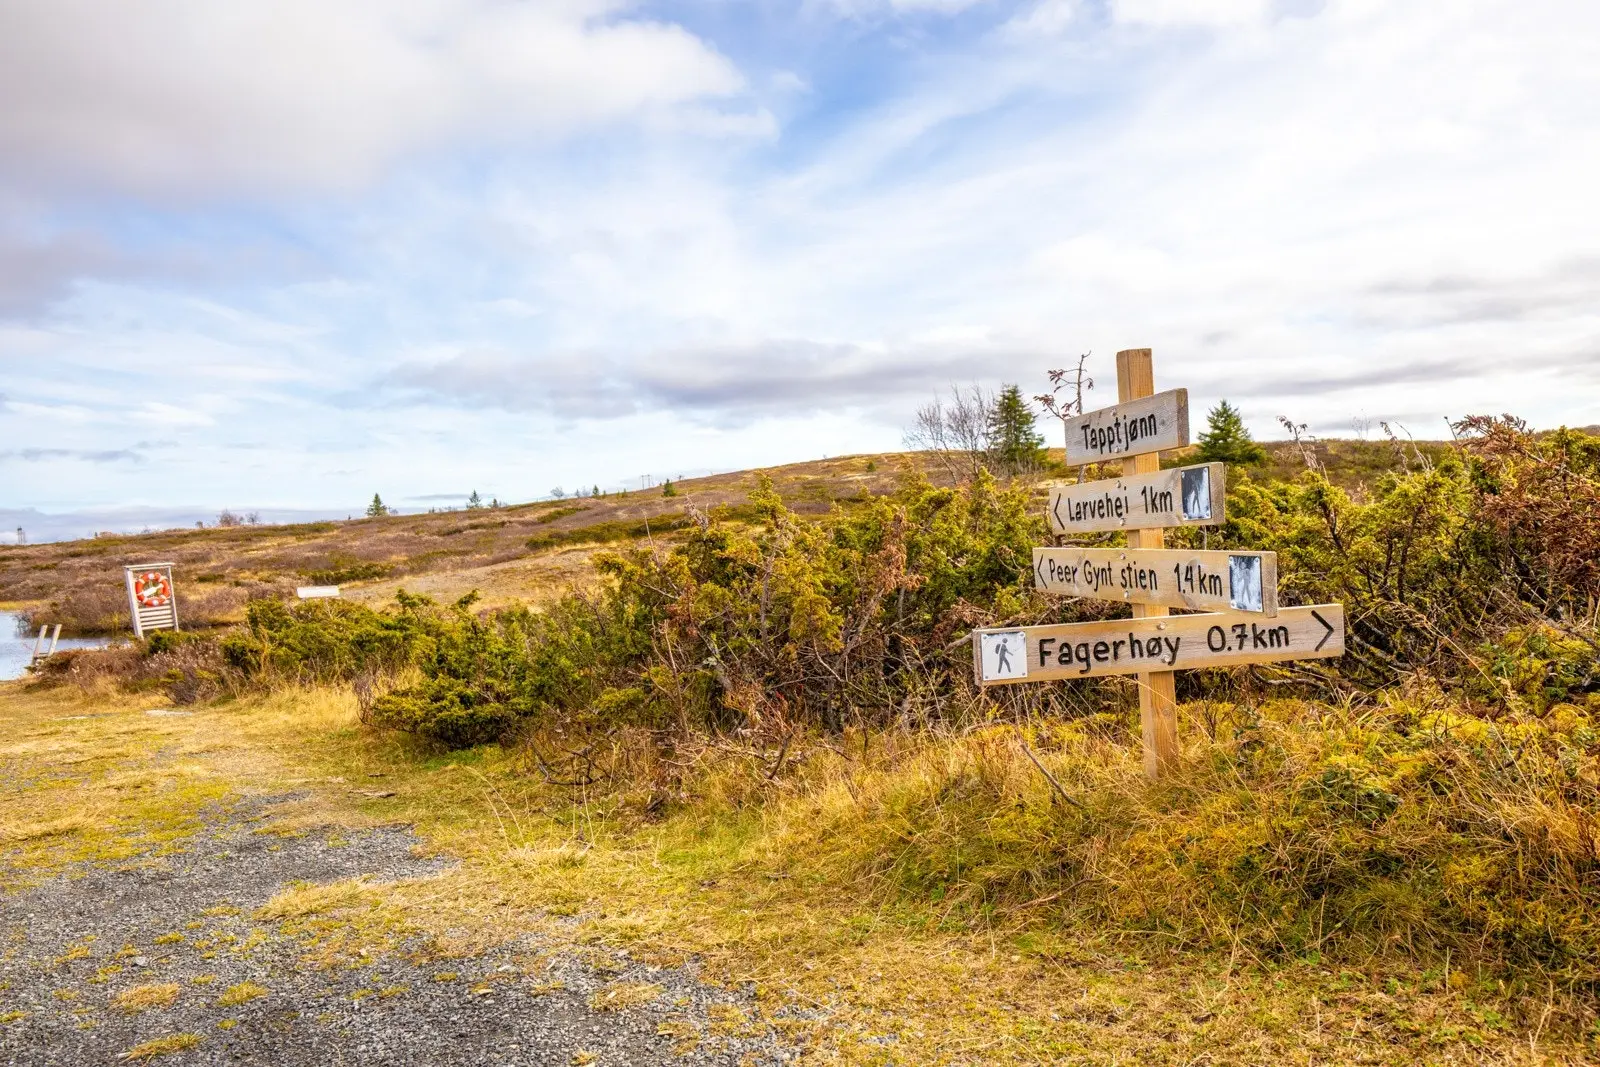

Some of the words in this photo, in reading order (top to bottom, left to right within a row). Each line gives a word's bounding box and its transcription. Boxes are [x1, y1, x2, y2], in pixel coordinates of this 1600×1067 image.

[1081, 413, 1157, 454] Tapptjønn
[1068, 486, 1129, 522] Larvehei
[1141, 485, 1173, 514] 1km
[1048, 558, 1078, 583] Peer
[1083, 560, 1114, 592] Gynt
[1120, 560, 1158, 591] stien
[1038, 632, 1181, 674] Fagerhøy
[1207, 622, 1290, 652] 0.7km
